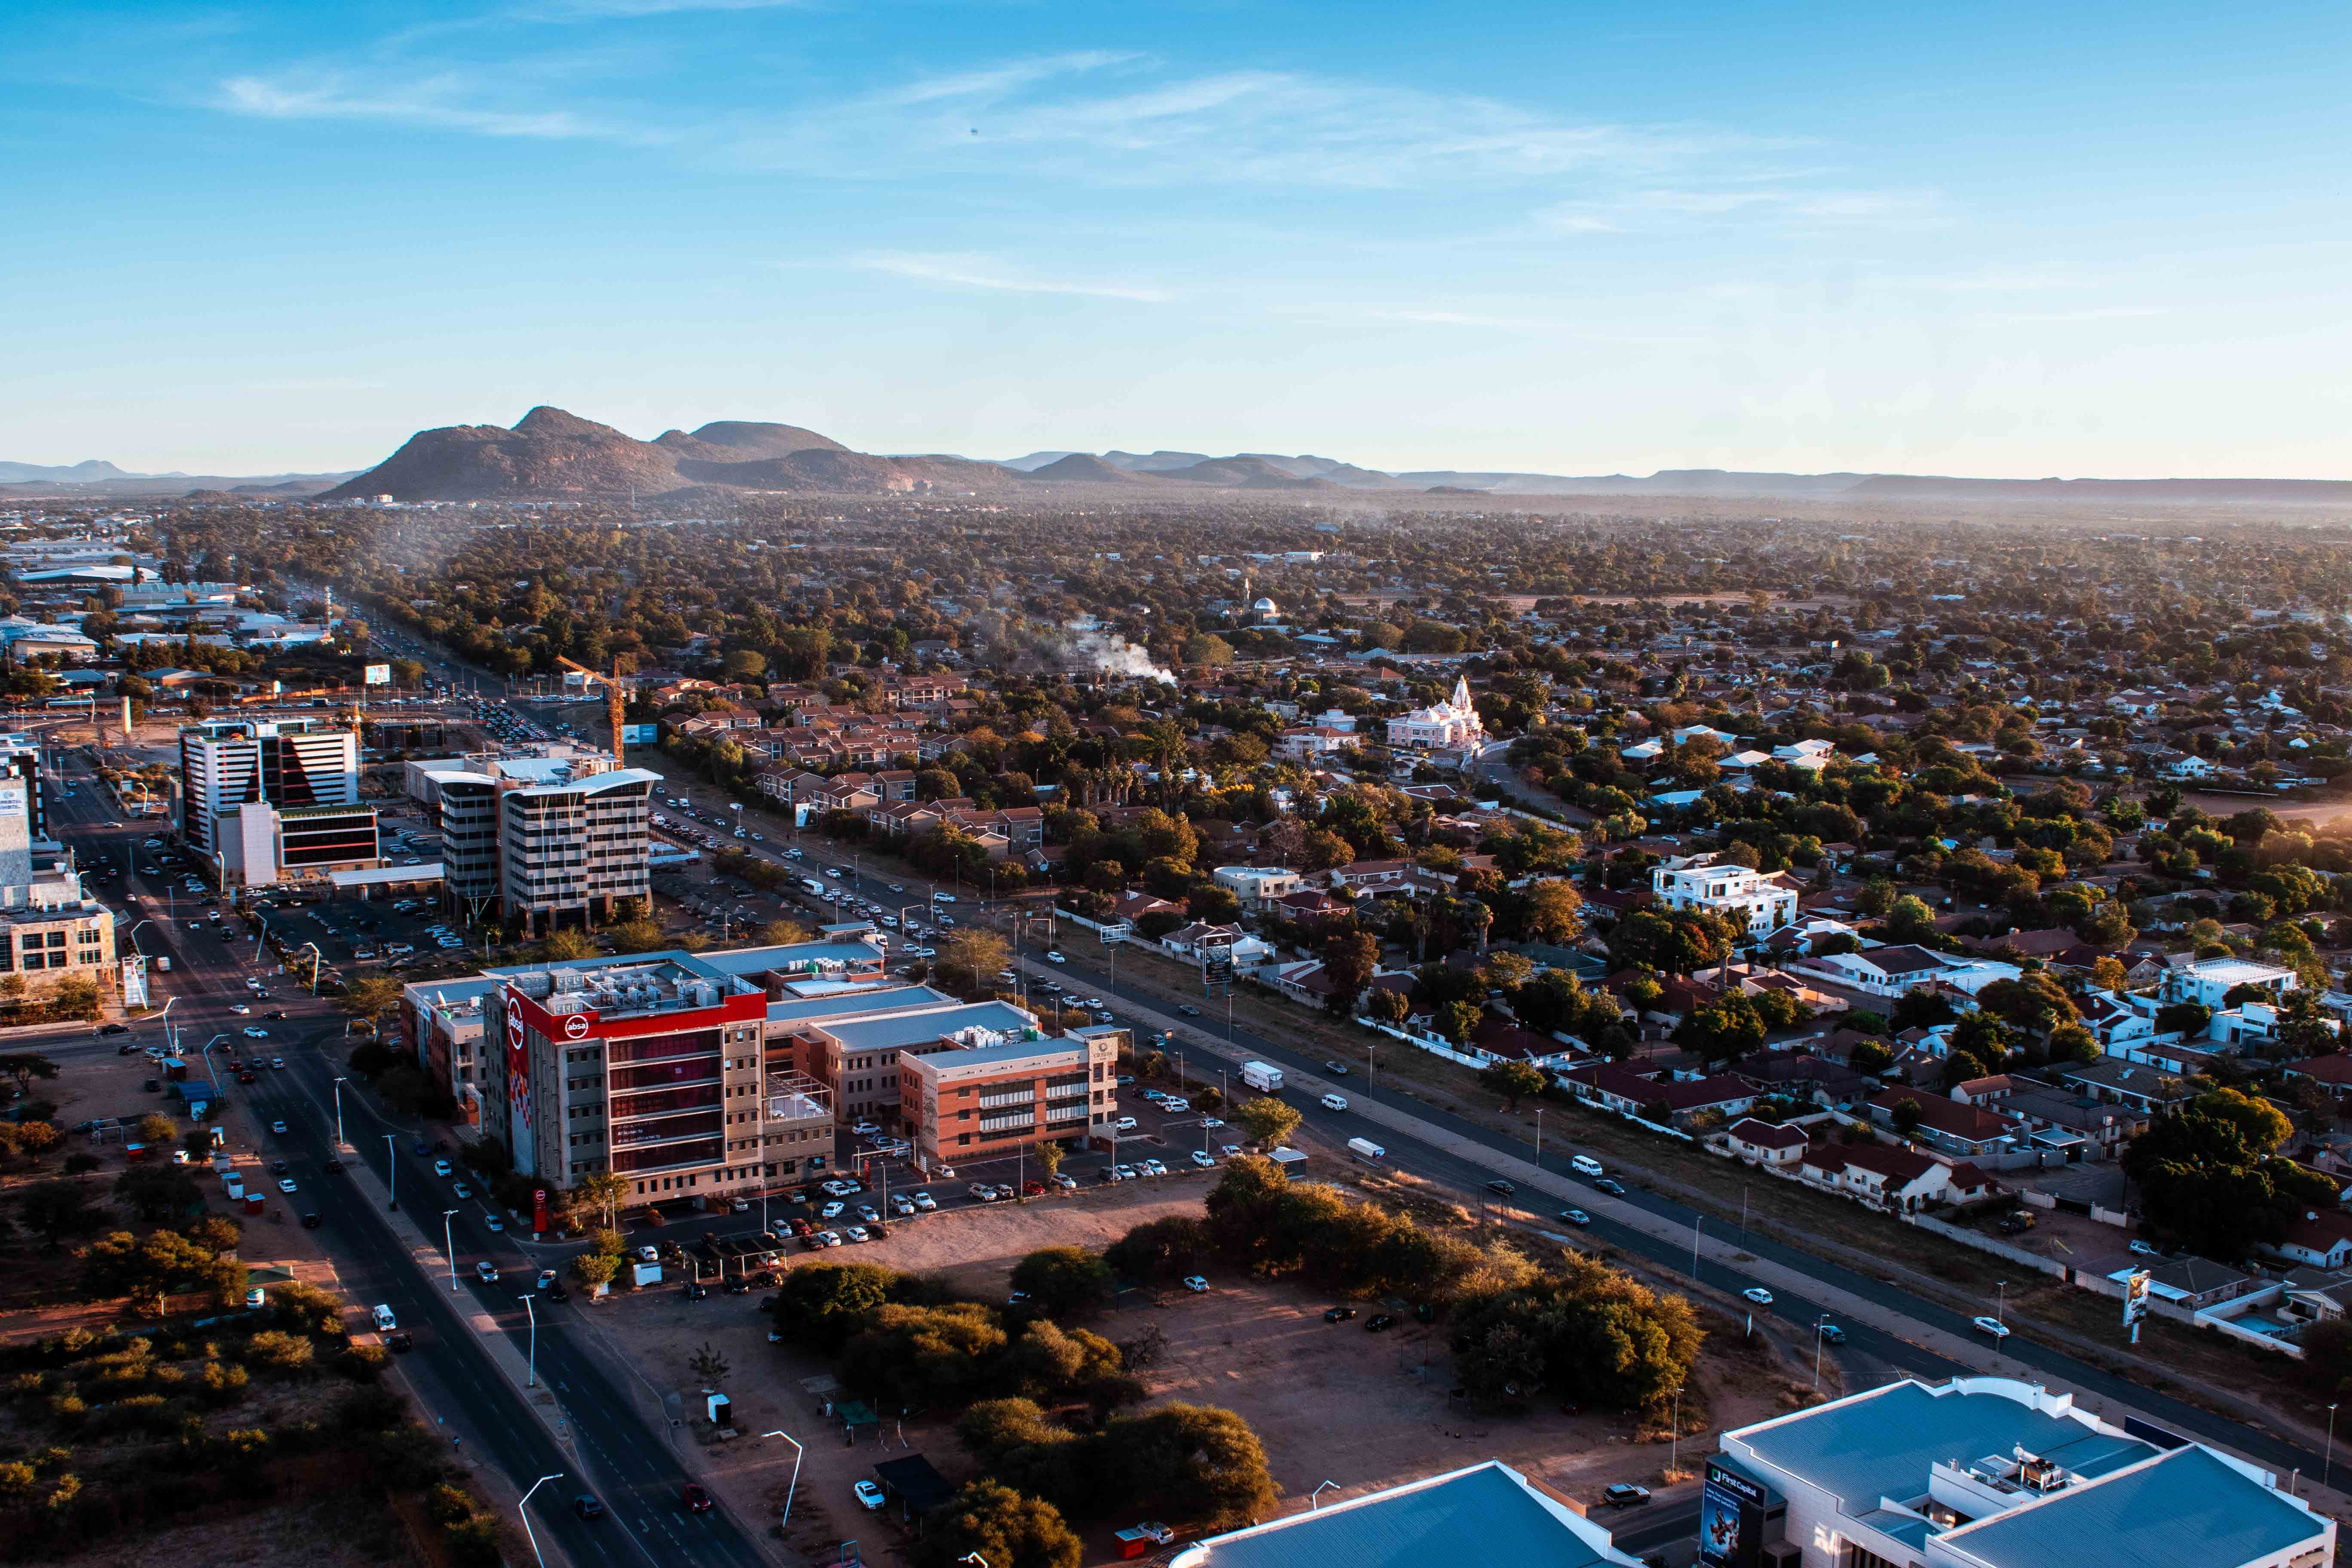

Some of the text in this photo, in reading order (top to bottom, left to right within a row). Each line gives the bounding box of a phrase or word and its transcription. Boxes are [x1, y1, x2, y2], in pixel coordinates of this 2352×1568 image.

[568, 1022, 586, 1030] absa
[1722, 1473, 1757, 1497] First Capital
